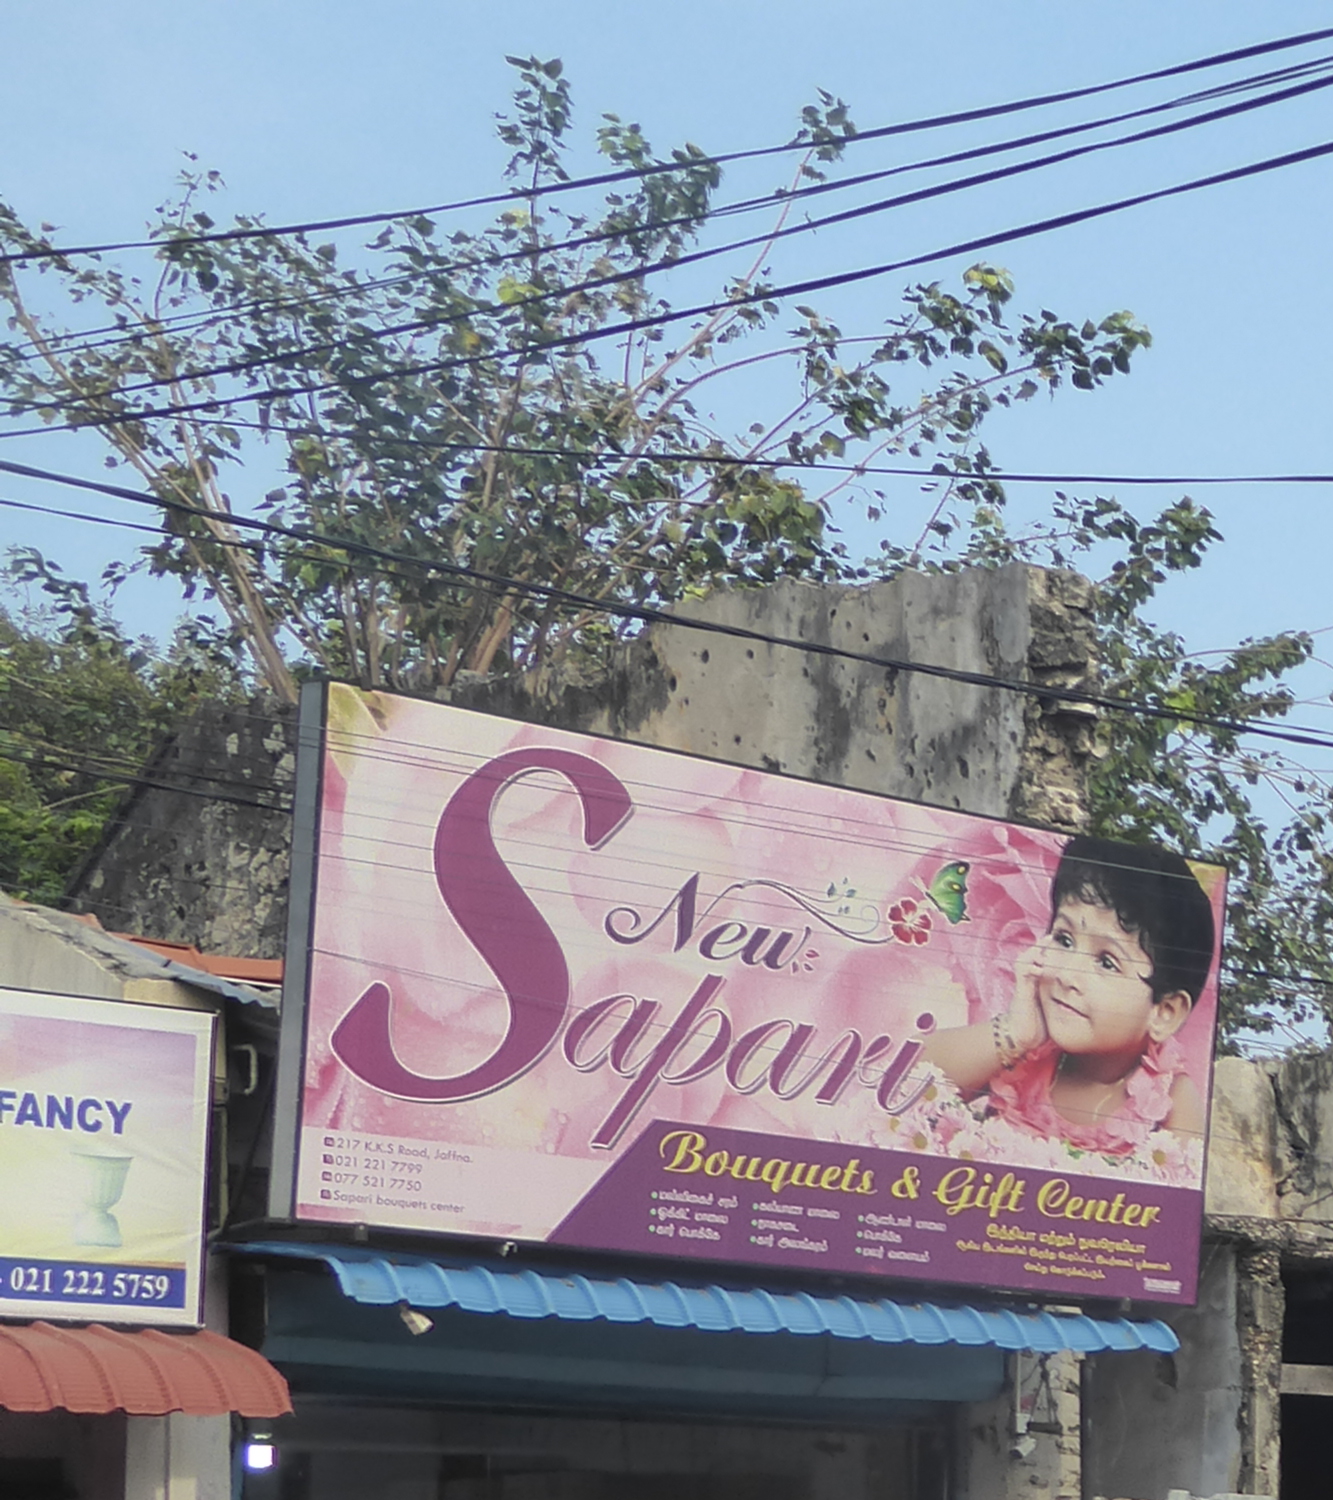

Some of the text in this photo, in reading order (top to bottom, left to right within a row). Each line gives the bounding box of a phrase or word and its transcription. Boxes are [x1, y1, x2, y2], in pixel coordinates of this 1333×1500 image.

[603, 872, 813, 974] New
[331, 746, 937, 1150] Sapari
[0, 1090, 132, 1135] FANCY
[337, 1137, 360, 1150] 217
[335, 1155, 423, 1174] 021 221 7799
[658, 1129, 1161, 1229] Bouquets & Gift Center
[334, 1172, 422, 1192] 077 521 7750
[333, 1189, 466, 1213] Sapari bouquets center
[10, 1267, 170, 1300] 021 222 5759
